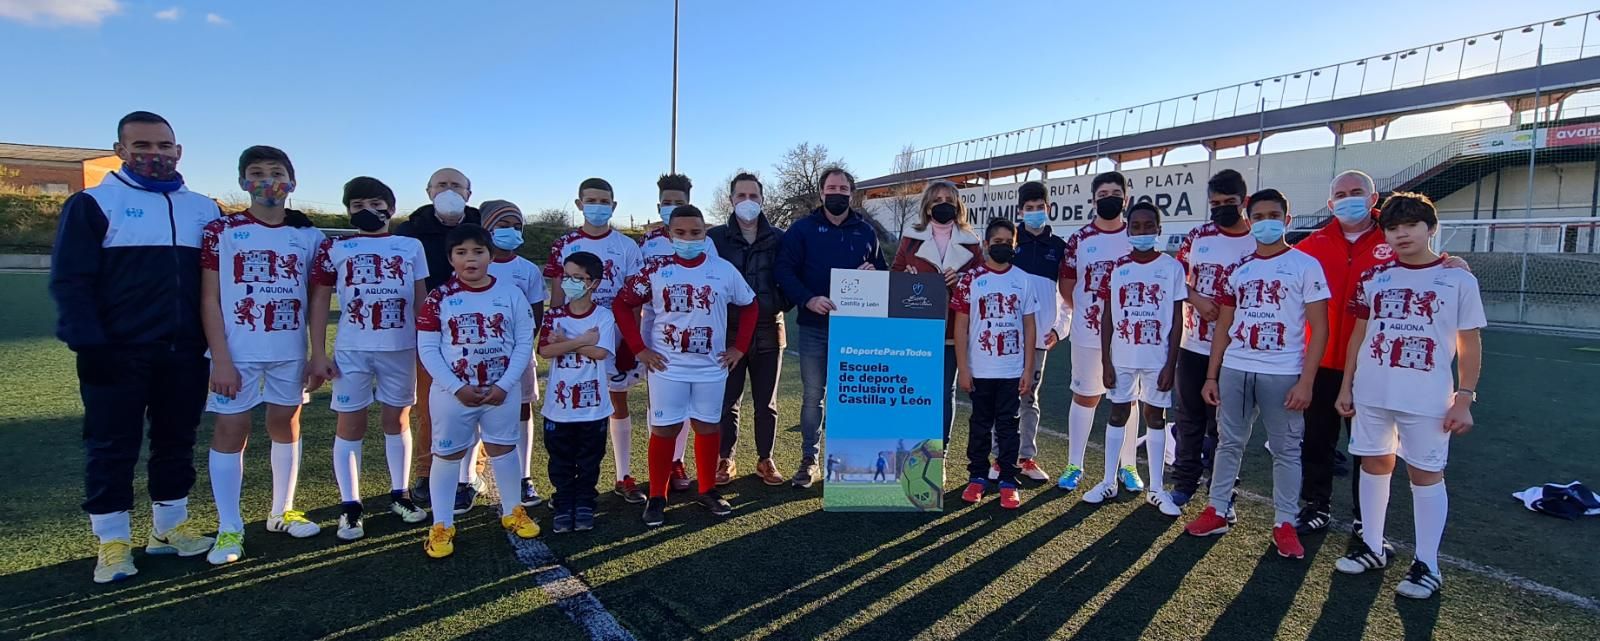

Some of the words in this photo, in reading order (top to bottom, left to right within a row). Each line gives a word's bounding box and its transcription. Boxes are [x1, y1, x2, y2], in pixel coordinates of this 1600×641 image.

[984, 190, 1018, 203] MUNICI
[1050, 184, 1080, 196] RUTA
[1145, 172, 1194, 188] PLATA
[1062, 205, 1083, 221] DE
[259, 286, 294, 294] AQUONA
[1247, 311, 1276, 319] AQUONA
[1389, 323, 1425, 332] AQUONA
[840, 346, 932, 357] #DeporteParaTodos
[839, 361, 889, 372] Escuela
[838, 373, 855, 383] de
[858, 373, 908, 385] deporte
[838, 384, 895, 394] inclusivo
[899, 385, 914, 395] de
[838, 394, 886, 405] Castilla
[889, 396, 897, 407] y
[901, 395, 932, 406] León
